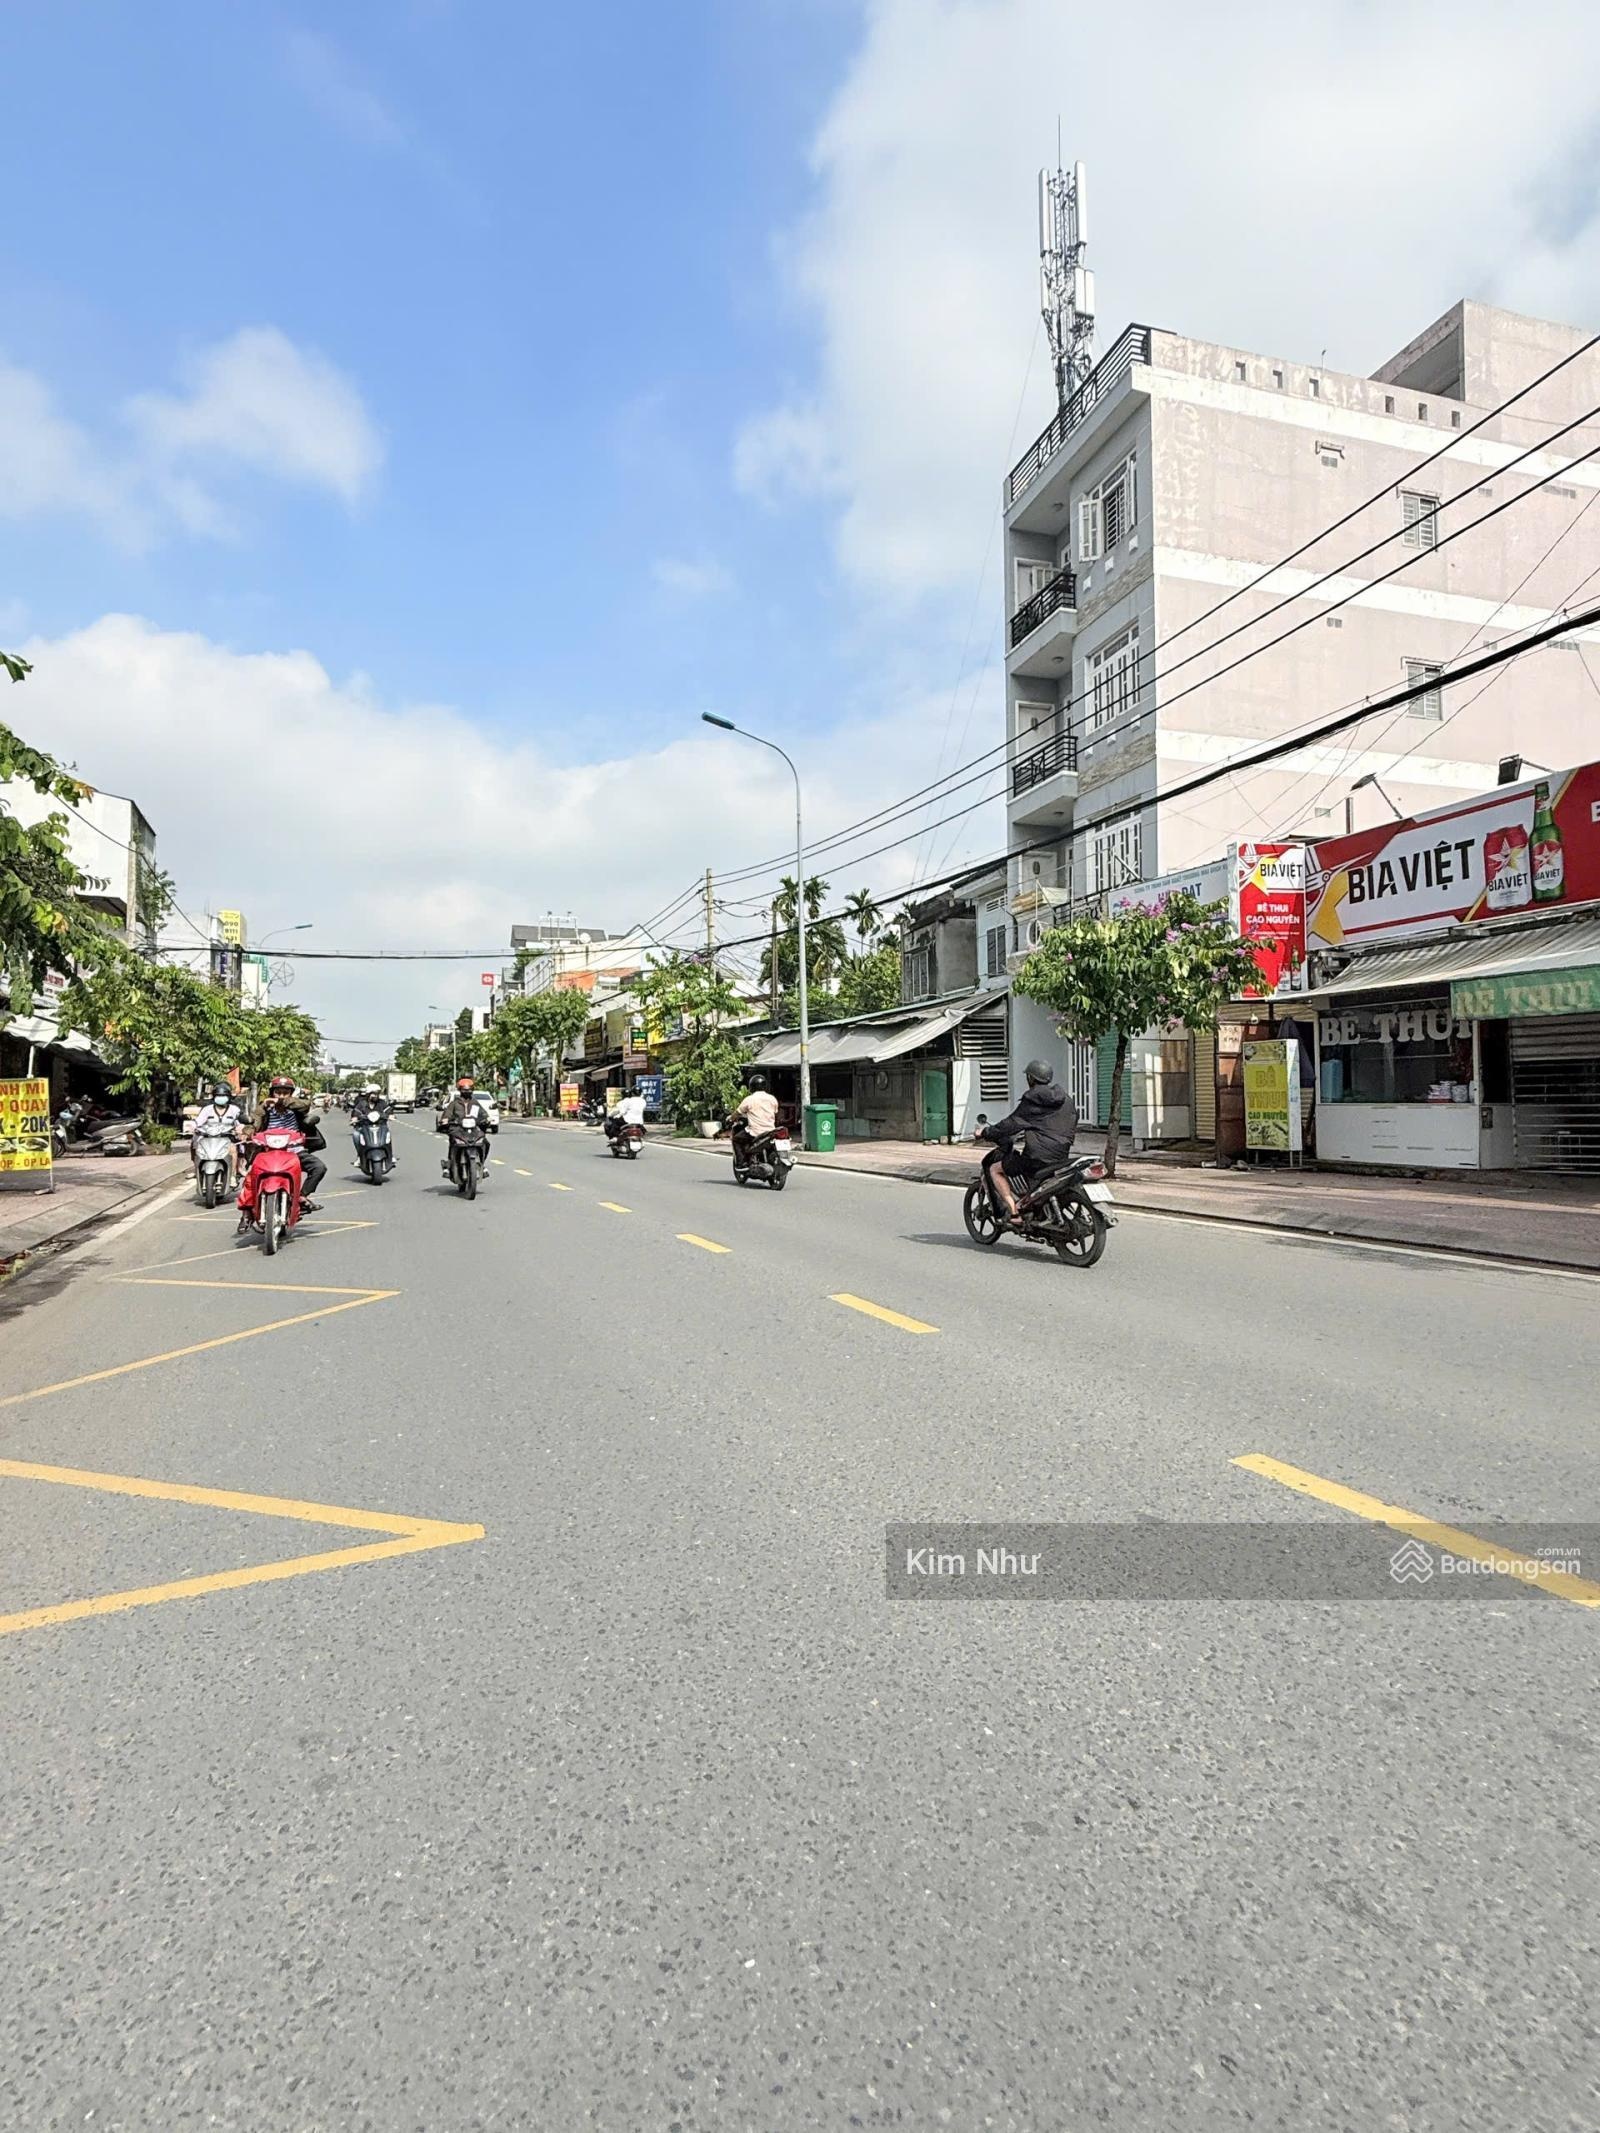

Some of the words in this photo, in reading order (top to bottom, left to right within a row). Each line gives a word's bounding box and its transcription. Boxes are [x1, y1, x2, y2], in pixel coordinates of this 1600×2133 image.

[1260, 864, 1279, 877] BIA
[1279, 862, 1303, 879] VIỆT
[1348, 860, 1398, 904] BIA
[1399, 838, 1475, 892] VIỆT
[1488, 878, 1504, 892] BIA
[1504, 873, 1528, 888] VIỆT
[1269, 903, 1289, 913] THUI
[1246, 915, 1265, 924] CAO
[1266, 913, 1300, 924] NGUYÊN
[1320, 1011, 1360, 1046] BÊ
[9, 1098, 48, 1113] QUAY
[21, 1116, 49, 1133] 20K
